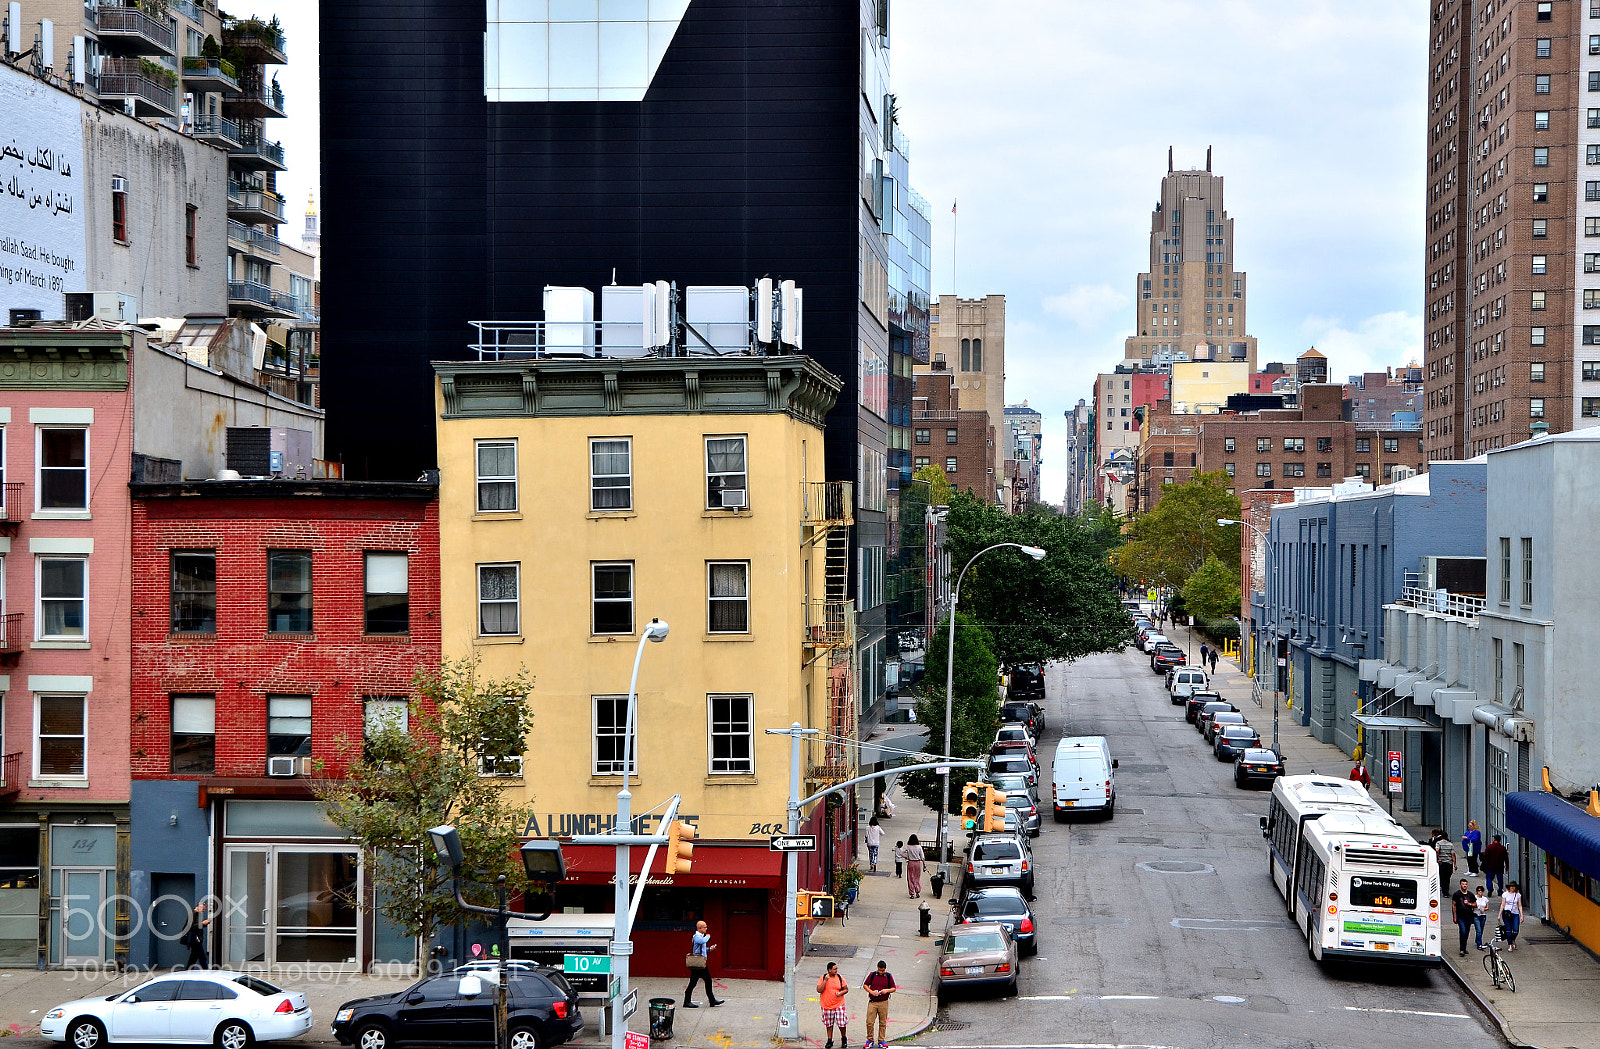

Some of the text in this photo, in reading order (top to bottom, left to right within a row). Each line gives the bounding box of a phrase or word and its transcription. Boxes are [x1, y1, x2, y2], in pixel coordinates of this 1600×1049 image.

[21, 241, 39, 260] Saad.
[40, 246, 50, 264] He
[52, 250, 75, 274] bought
[15, 267, 22, 282] of
[25, 268, 46, 289] March
[548, 815, 700, 838] LUNCHNEE
[72, 839, 98, 851] 134
[574, 957, 590, 971] 10
